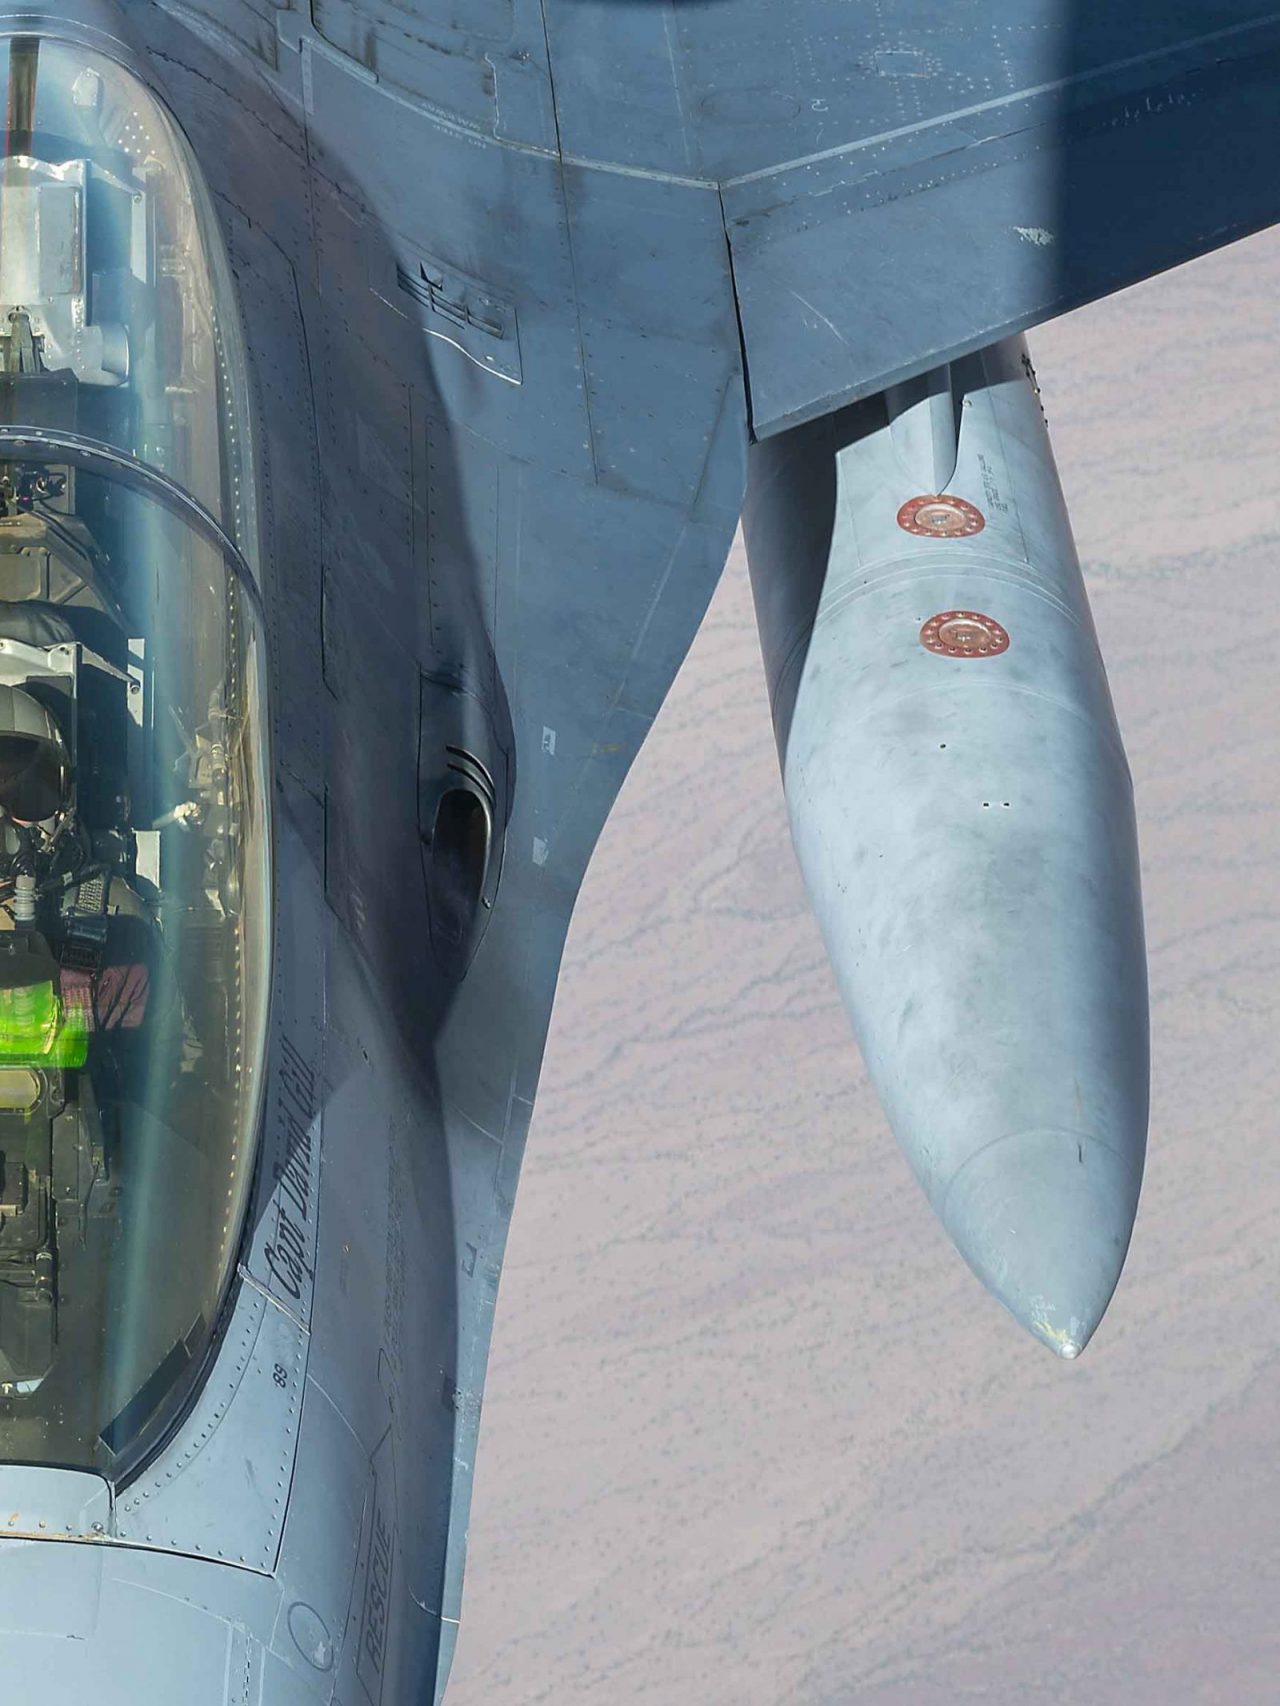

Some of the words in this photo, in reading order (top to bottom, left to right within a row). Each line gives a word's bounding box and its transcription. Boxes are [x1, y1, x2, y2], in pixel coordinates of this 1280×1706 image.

[272, 1110, 312, 1221] David
[264, 1198, 313, 1301] Capt
[365, 1508, 391, 1675] RESCUE
